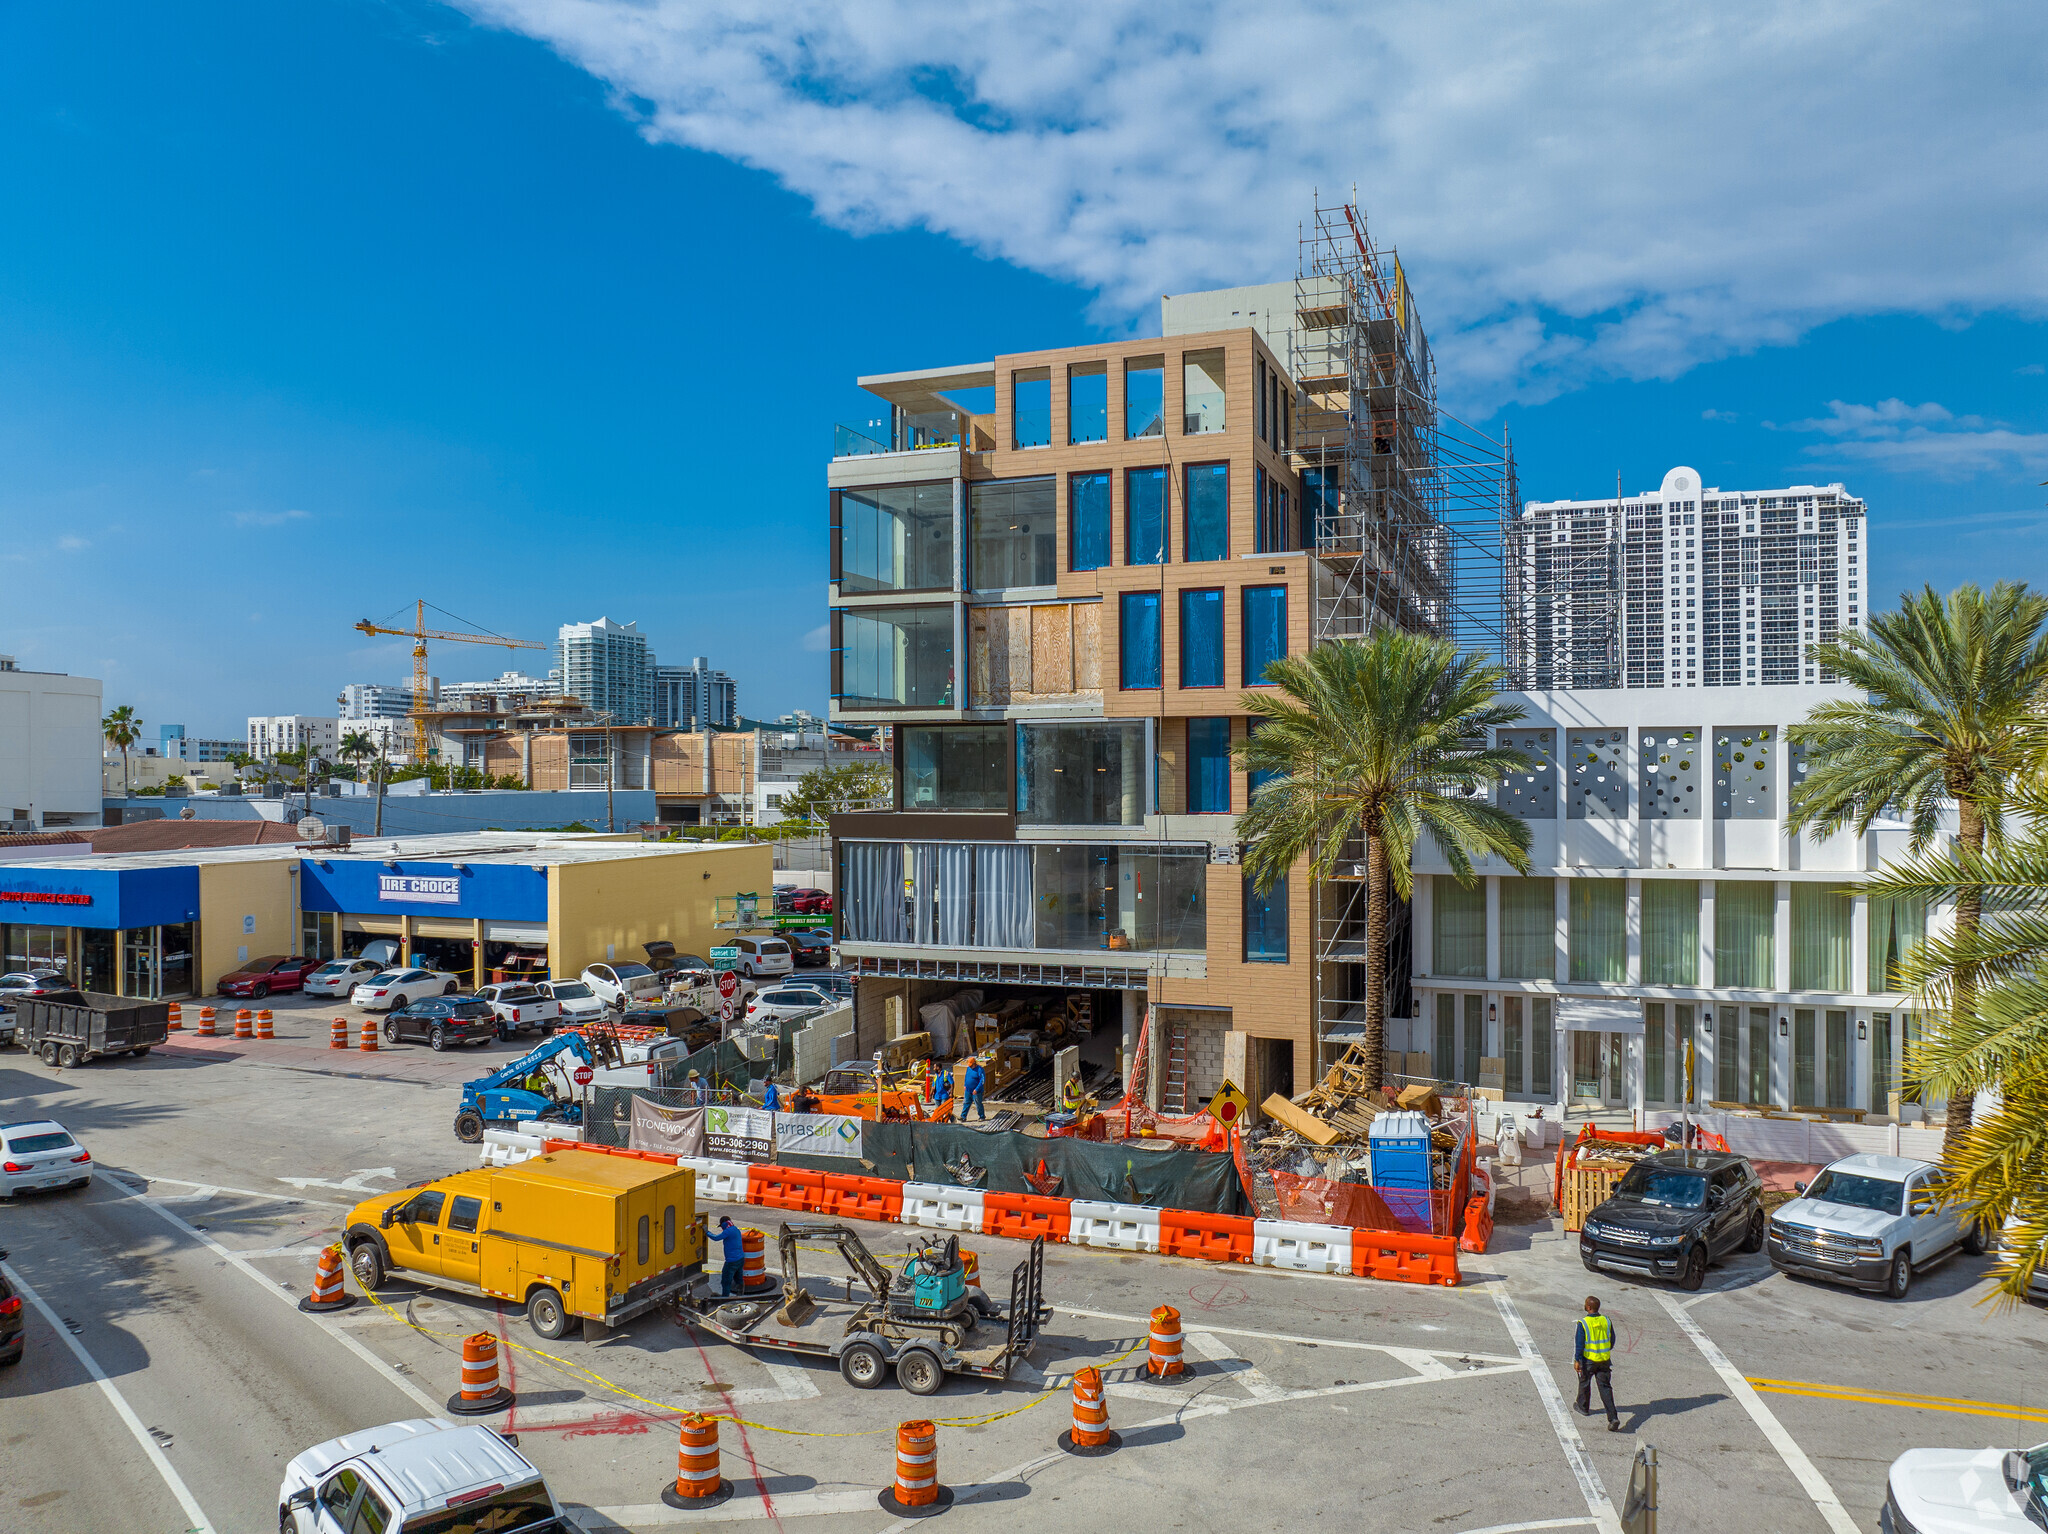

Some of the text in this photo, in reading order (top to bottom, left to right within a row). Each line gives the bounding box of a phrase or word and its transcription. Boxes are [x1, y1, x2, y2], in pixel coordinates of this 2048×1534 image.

[380, 876, 459, 893] TIRE CHOICE
[1, 891, 91, 904] AUTO SERVICE CENTER
[711, 949, 729, 957] Sunset
[720, 978, 736, 992] STOP
[574, 1071, 593, 1080] STOP
[636, 1117, 696, 1138] STONEWORKS
[776, 1122, 834, 1137] arrasair
[708, 1136, 769, 1151] 305-306-2960
